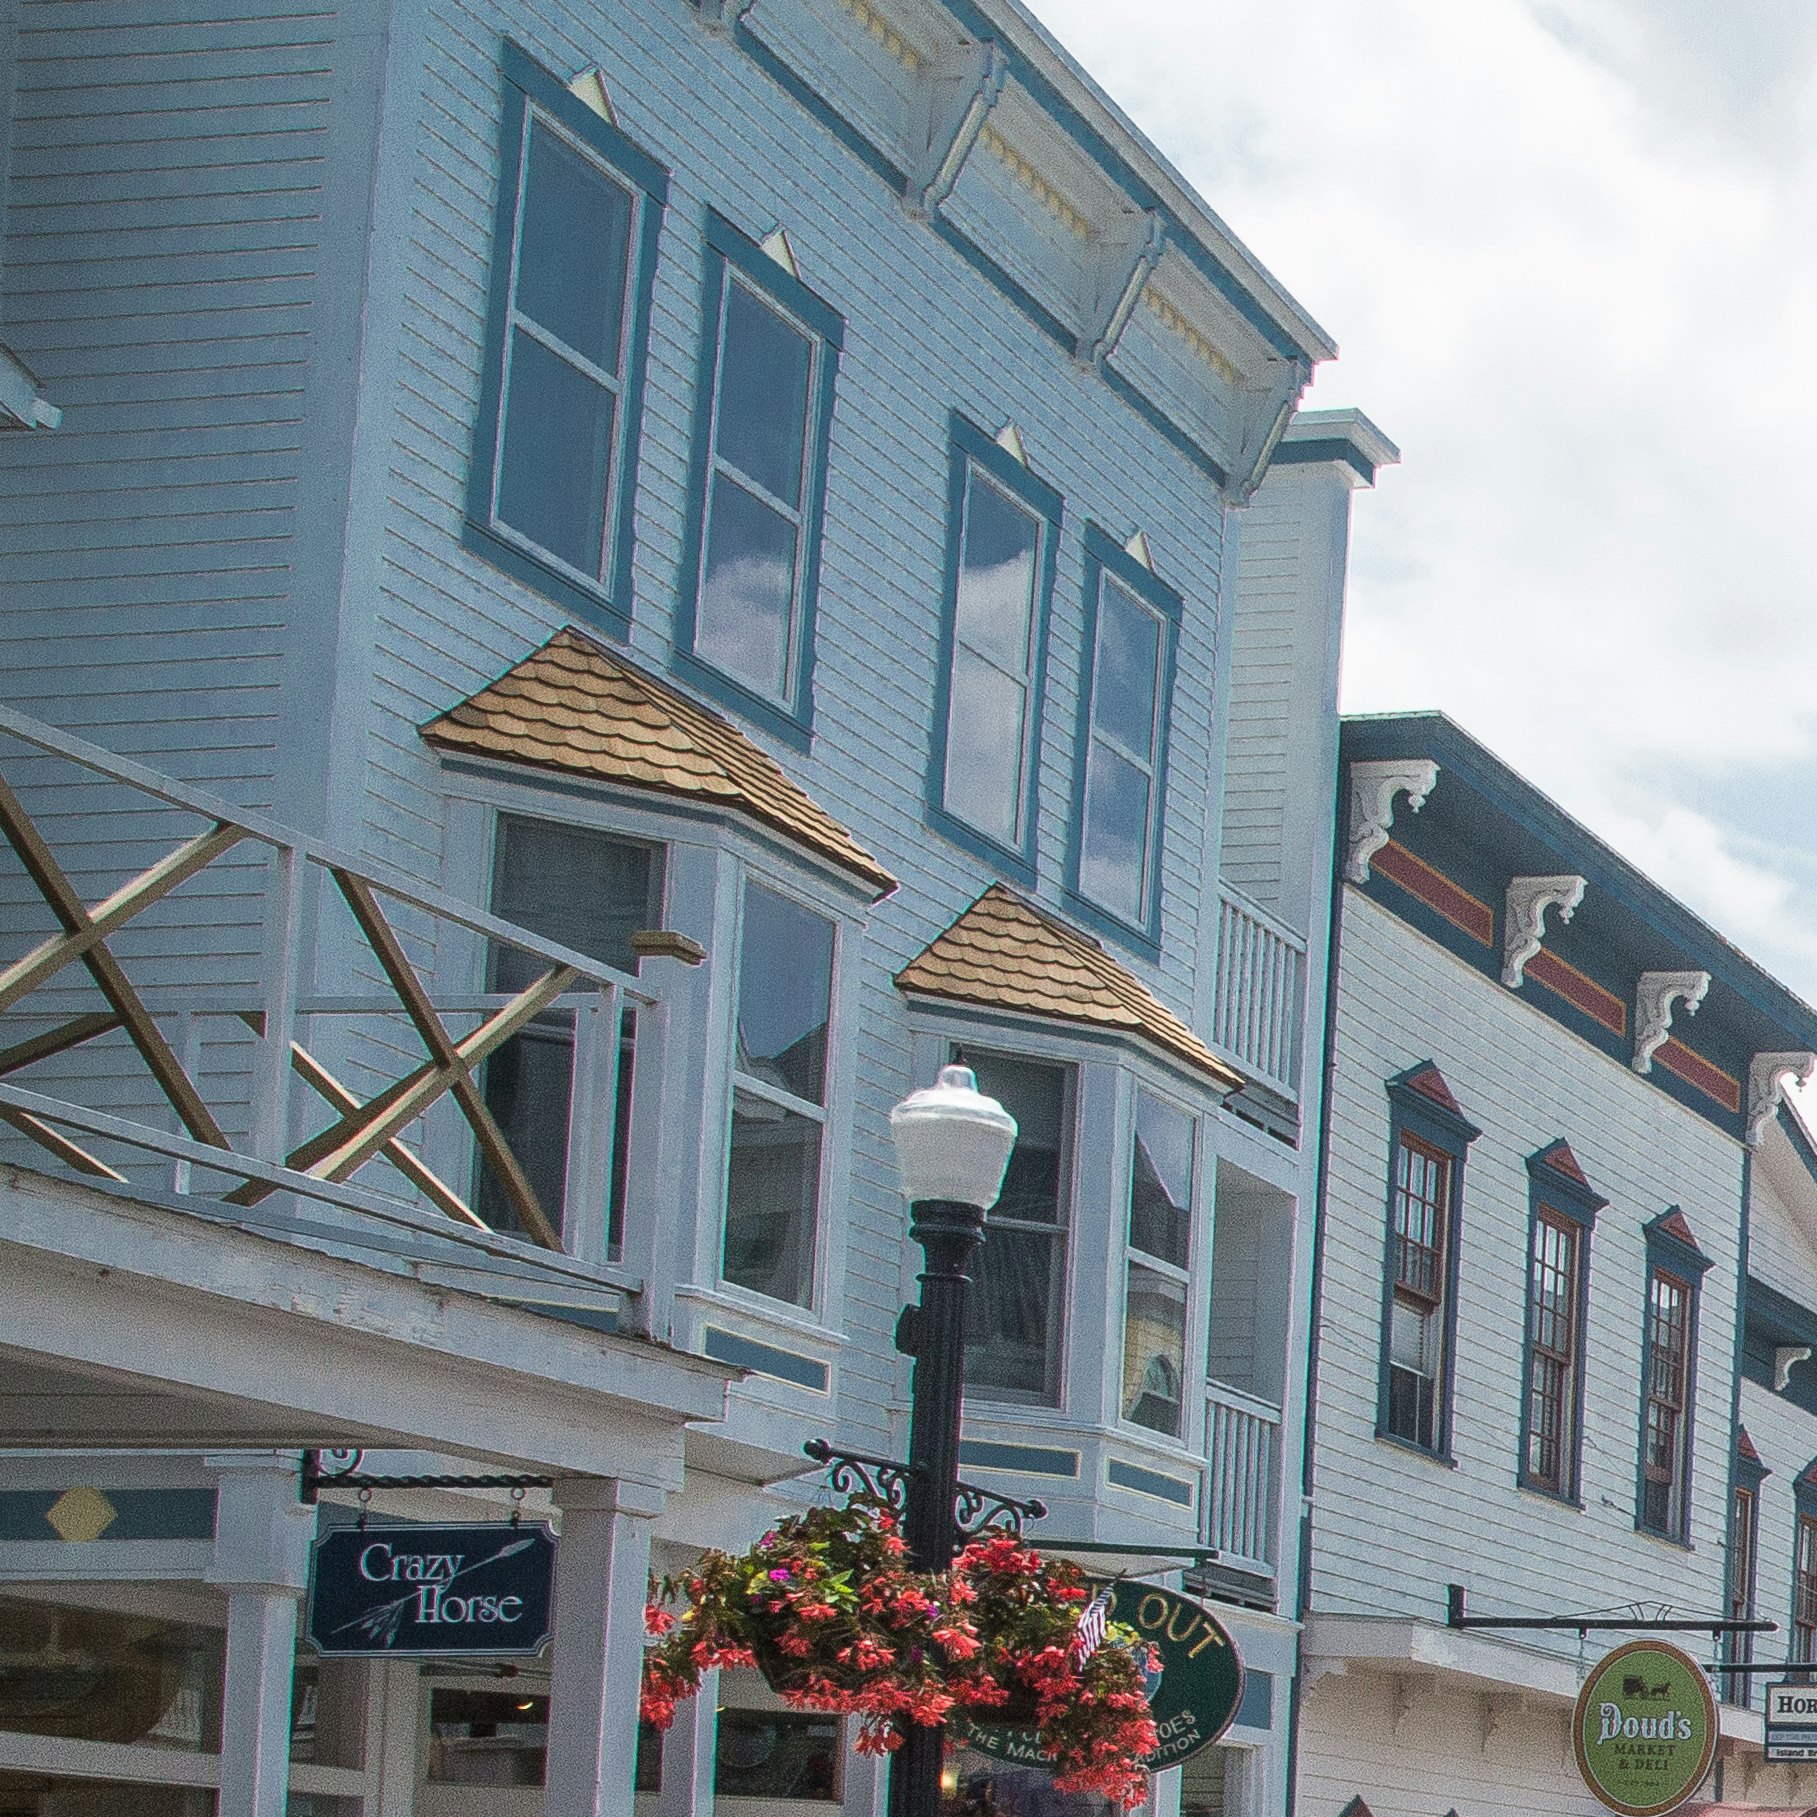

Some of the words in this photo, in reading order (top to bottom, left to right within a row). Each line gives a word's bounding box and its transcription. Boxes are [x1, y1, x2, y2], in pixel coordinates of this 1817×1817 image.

[360, 1542, 465, 1592] Crazy
[415, 1584, 523, 1623] Horse
[1138, 1593, 1225, 1659] OUT
[1597, 1702, 1692, 1745] Doud's
[1615, 1744, 1676, 1756] MARKET
[1634, 1760, 1669, 1771] DELI
[1777, 1749, 1804, 1758] Island
